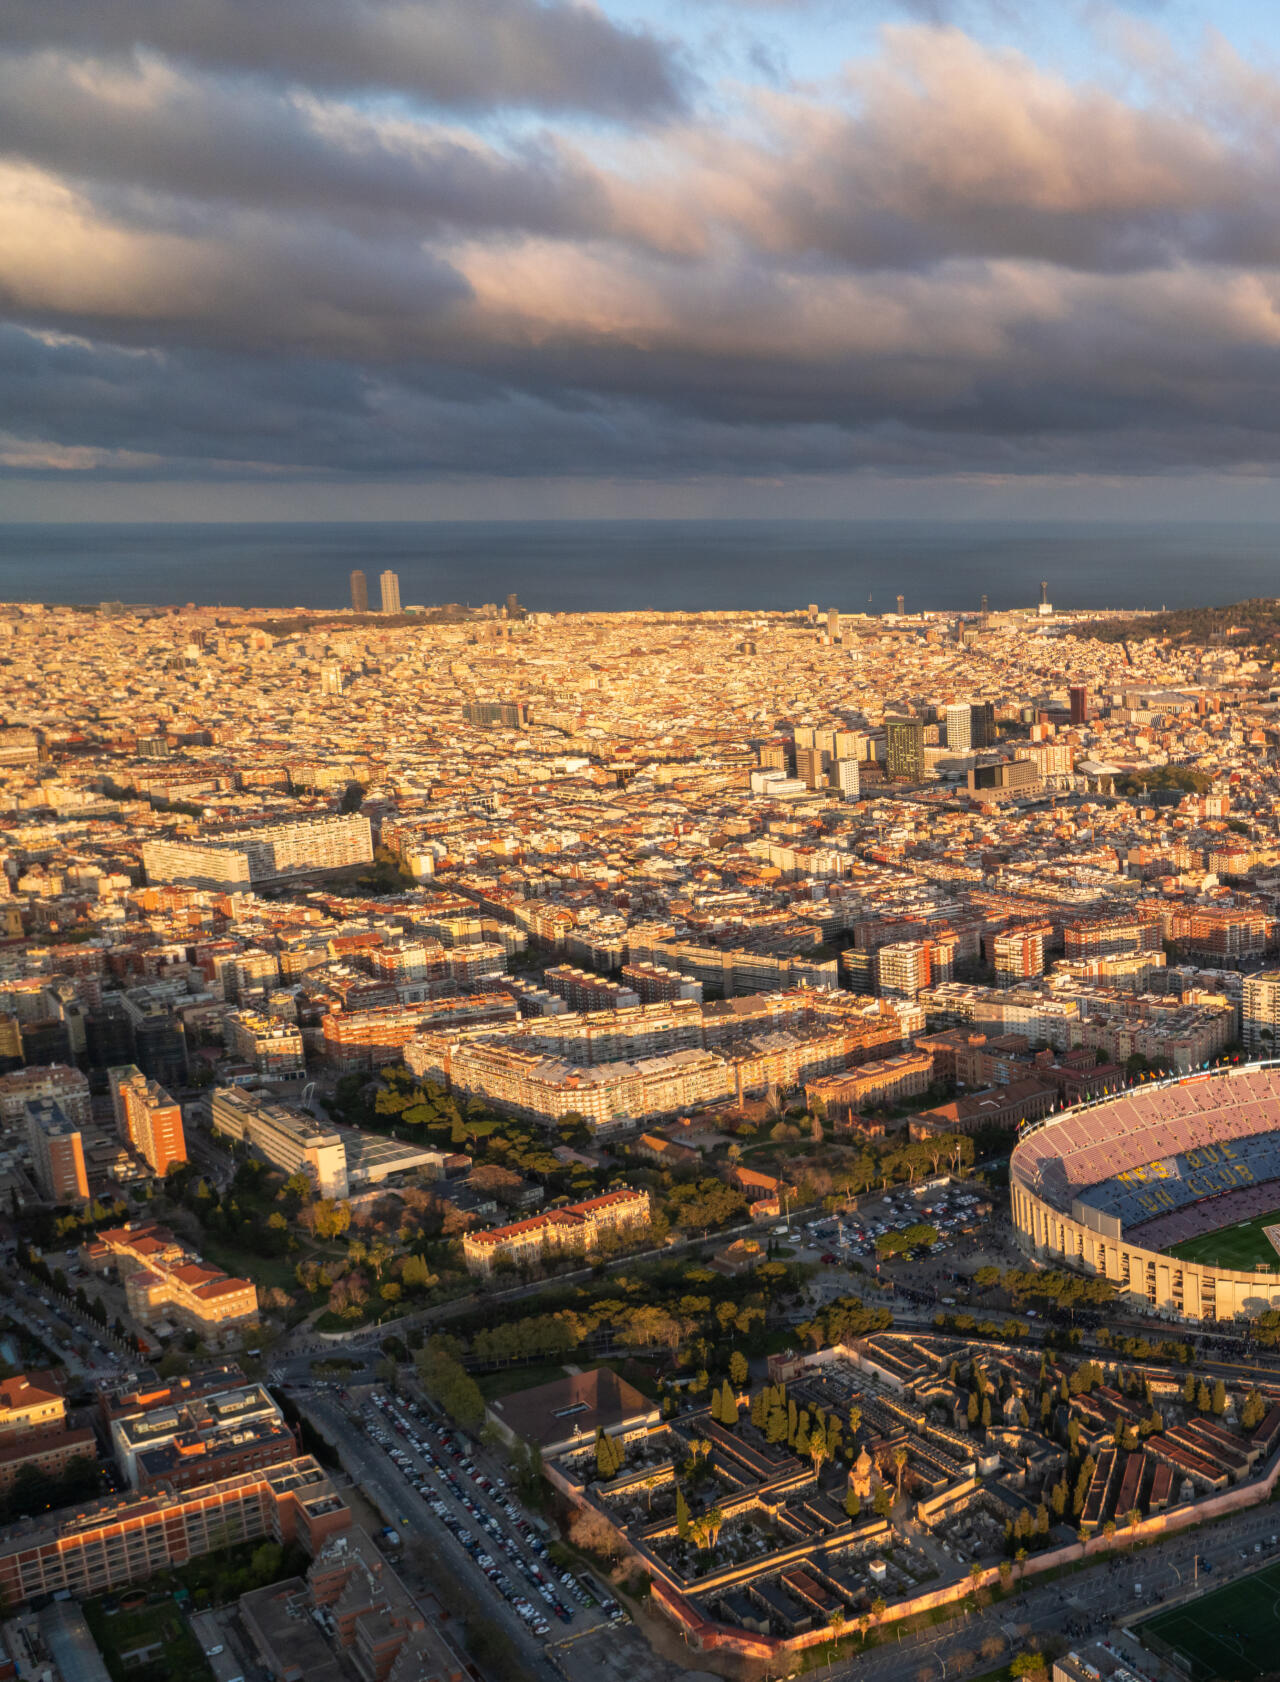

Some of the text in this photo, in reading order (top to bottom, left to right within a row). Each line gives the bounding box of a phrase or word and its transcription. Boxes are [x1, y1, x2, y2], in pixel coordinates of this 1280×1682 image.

[1186, 1142, 1237, 1168] QUE
[1138, 1164, 1254, 1212] UN CLUB
